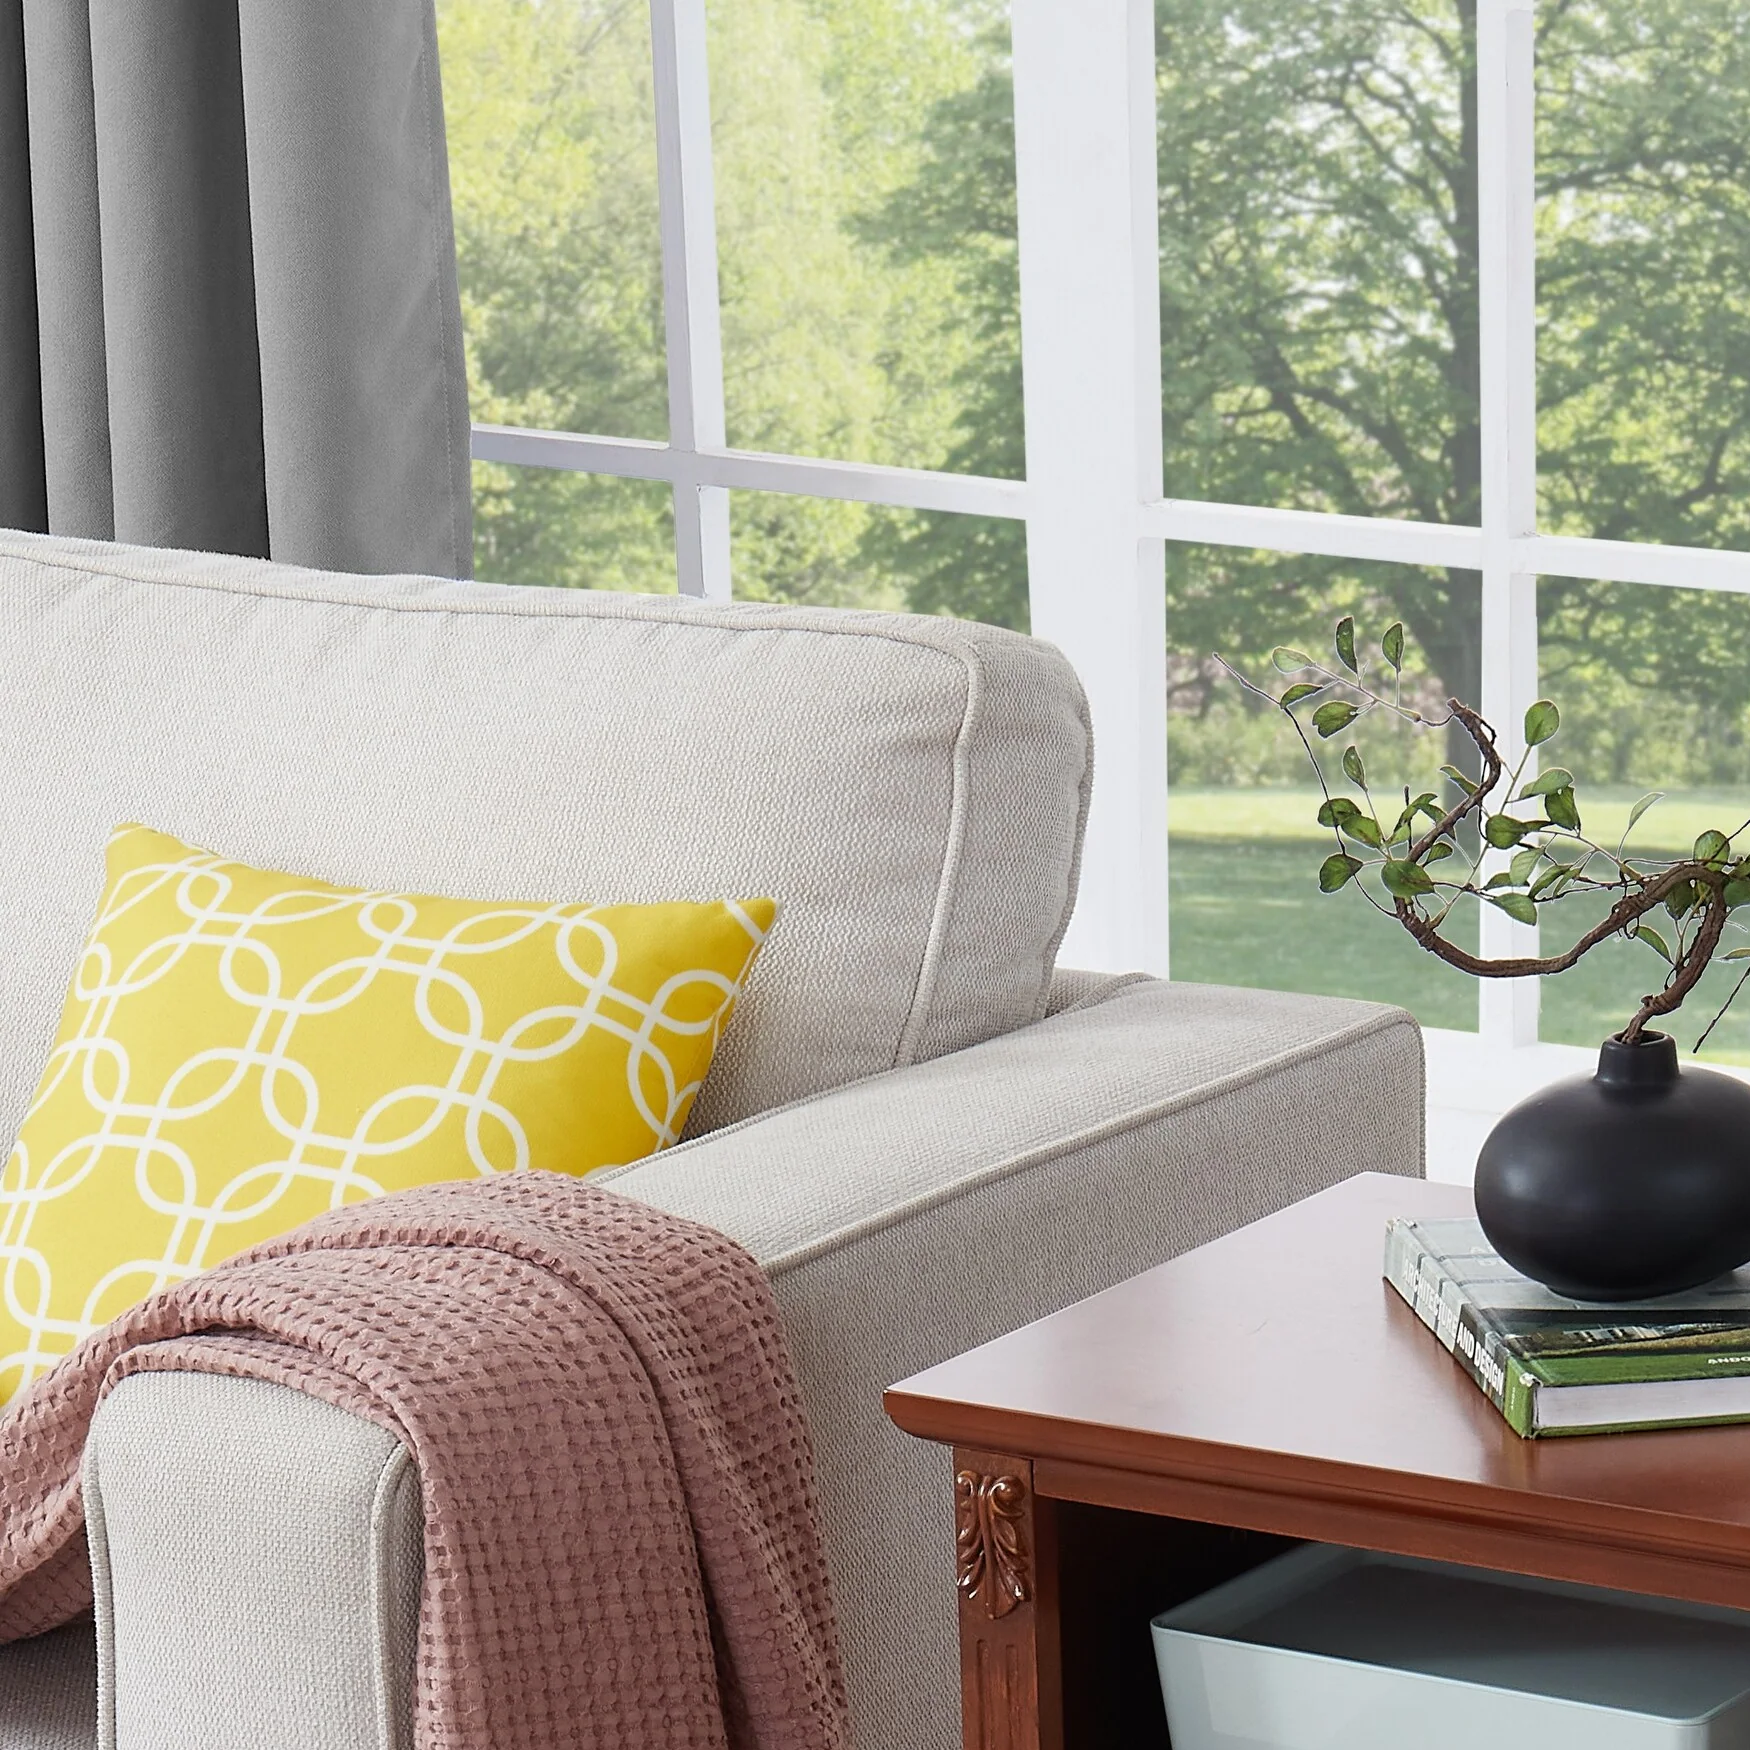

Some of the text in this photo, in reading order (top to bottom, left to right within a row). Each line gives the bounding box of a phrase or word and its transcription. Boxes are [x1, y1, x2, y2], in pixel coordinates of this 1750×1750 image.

[1402, 1258, 1505, 1397] ARCHITECTURE AND DESIGN
